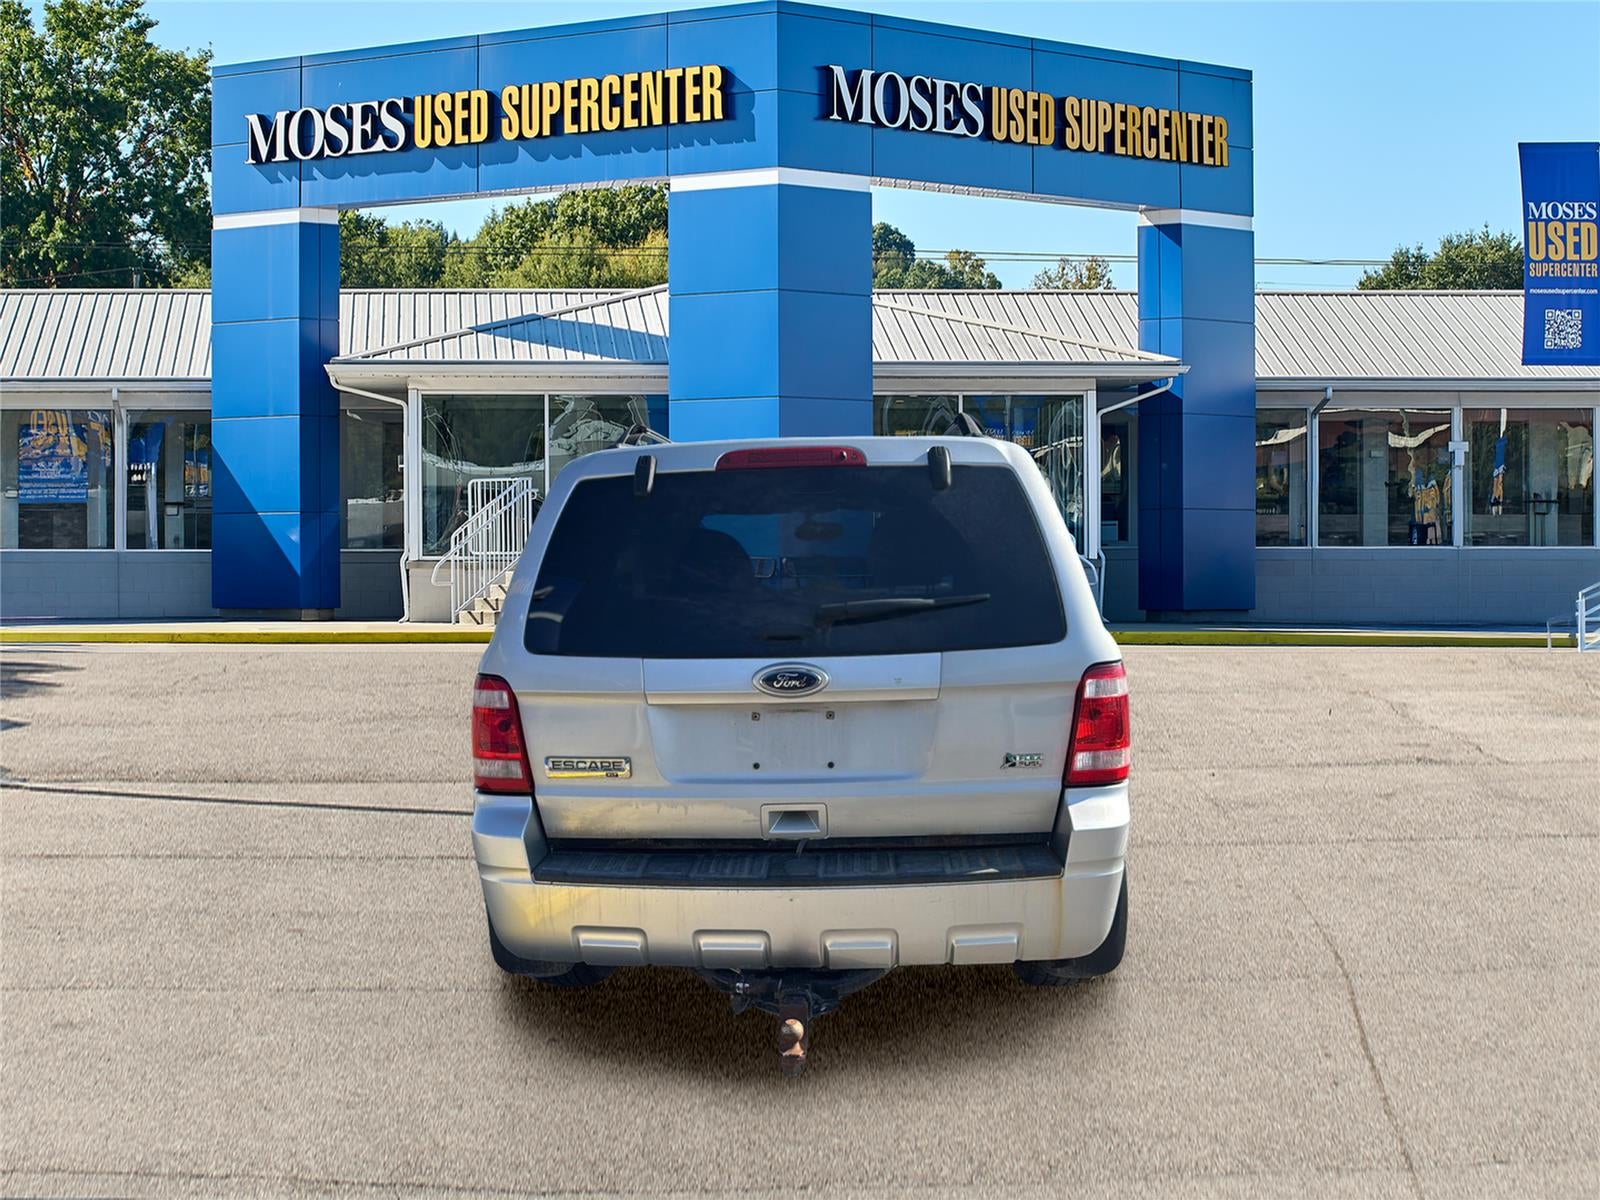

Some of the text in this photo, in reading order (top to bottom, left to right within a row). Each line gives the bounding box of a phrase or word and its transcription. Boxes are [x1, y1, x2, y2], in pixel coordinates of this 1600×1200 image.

[244, 64, 723, 164] MOSES USED SUPERCENTER
[829, 65, 1229, 167] MOSES USED SUPERCENTER
[1527, 201, 1597, 220] MOSES
[1528, 221, 1598, 260] USED
[1529, 262, 1598, 277] SUPERCENTER
[773, 672, 807, 688] Ford
[551, 760, 624, 771] ESCAPE
